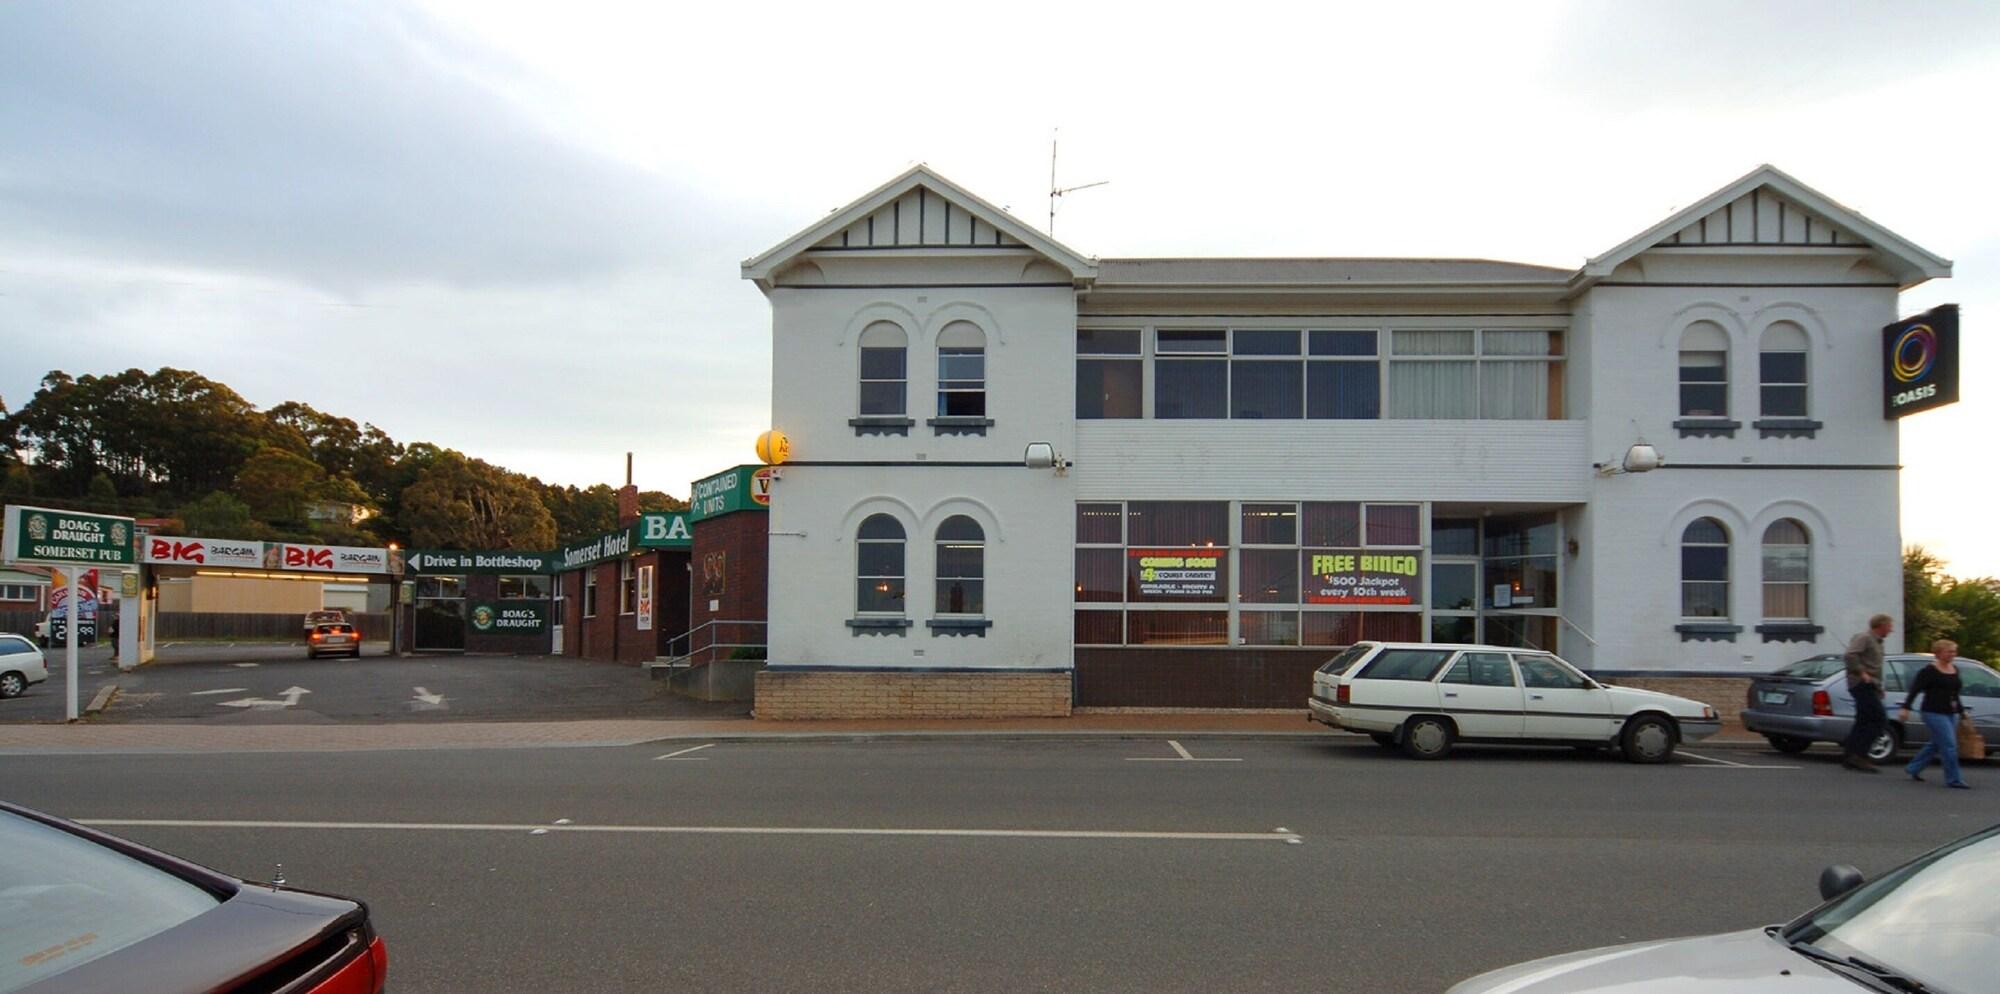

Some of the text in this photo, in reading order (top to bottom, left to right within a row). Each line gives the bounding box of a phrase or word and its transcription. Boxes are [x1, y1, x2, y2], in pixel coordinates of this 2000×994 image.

[1896, 384, 1936, 405] OASIS
[696, 473, 737, 499] CONTAINED
[704, 495, 725, 515] UNITS
[59, 519, 101, 532] BOAG'S
[644, 515, 692, 539] BA
[52, 529, 105, 543] DRAUGHT
[33, 545, 121, 560] SOMERSET PUB
[151, 539, 205, 564] BIG
[564, 529, 630, 567] Somerset Hotel
[285, 546, 333, 569] BIG
[424, 555, 542, 570] Drive in Bottleshop
[1312, 555, 1417, 576] FREE BINGO
[1329, 576, 1399, 587] $500 Jackpot
[1320, 587, 1408, 598] every 10th week
[502, 609, 536, 619] BOAG'S
[496, 619, 542, 628] DRAUGHT
